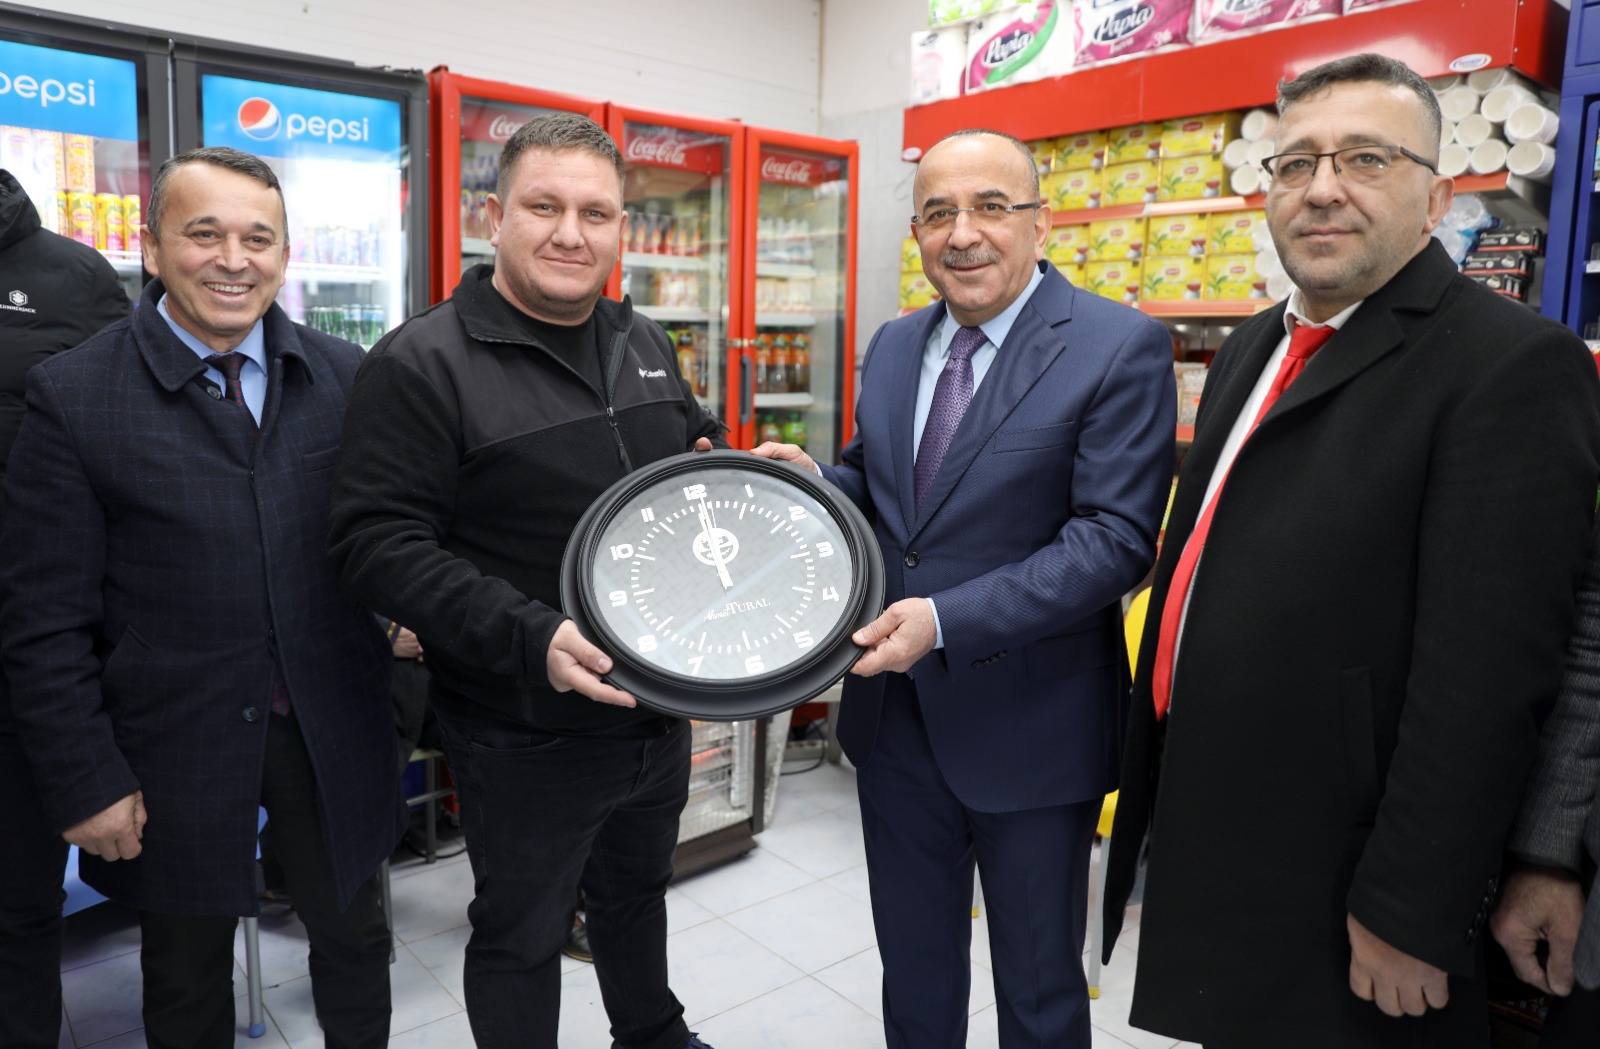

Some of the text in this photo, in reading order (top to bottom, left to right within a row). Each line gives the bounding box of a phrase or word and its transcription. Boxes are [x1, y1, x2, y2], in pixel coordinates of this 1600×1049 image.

[286, 113, 369, 145] pepsi
[683, 484, 707, 500] 12
[744, 484, 754, 498] 1
[641, 507, 655, 523] 11
[788, 505, 809, 521] 2
[610, 543, 634, 561] 10
[816, 541, 834, 558] 3
[608, 590, 628, 607] 9
[822, 586, 840, 602] 4
[726, 598, 771, 615] TURAL
[637, 634, 658, 653] 8
[792, 629, 814, 649] 5
[687, 655, 705, 676] 7
[744, 654, 765, 675] 6
